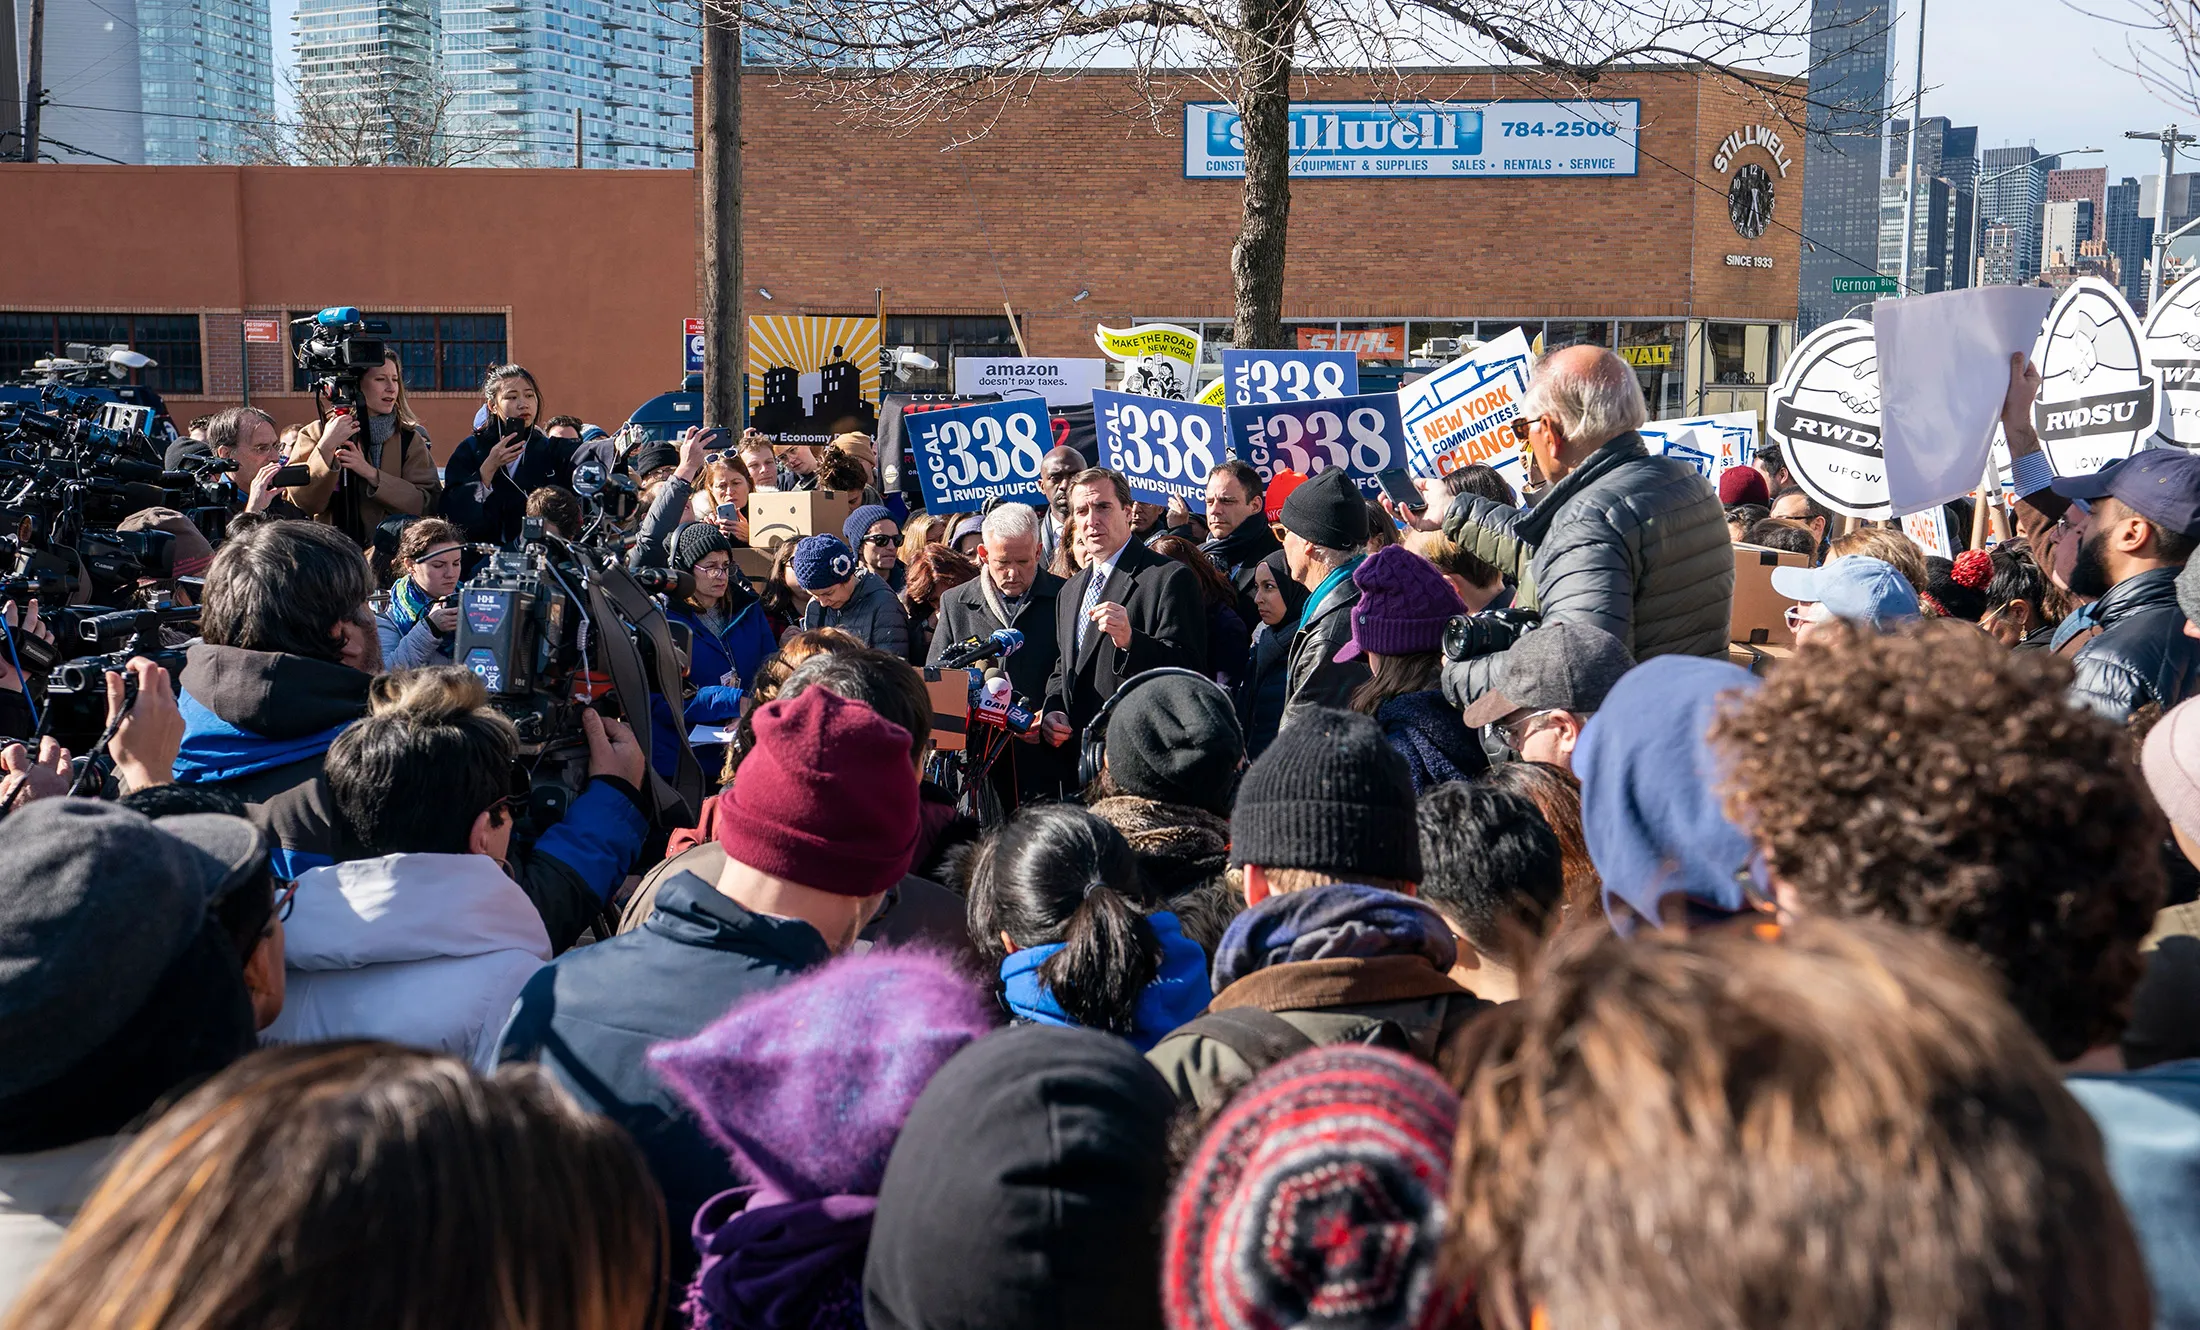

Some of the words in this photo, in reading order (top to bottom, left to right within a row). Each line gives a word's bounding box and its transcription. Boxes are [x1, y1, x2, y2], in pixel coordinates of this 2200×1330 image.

[1501, 121, 1616, 137] 784-2500
[1713, 124, 1792, 179] STILLWELL
[1295, 160, 1356, 171] EQUIPMENT
[1361, 160, 1370, 171] &
[1376, 160, 1428, 171] SUPPLIES
[1452, 159, 1486, 170] SALES
[1503, 159, 1552, 170] RENTALS
[1570, 158, 1616, 169] SERVICE
[1725, 254, 1751, 267] SINCE
[1753, 257, 1773, 268] 1933
[1835, 279, 1876, 291] Vernon
[1112, 338, 1140, 348] MAKE
[1140, 333, 1161, 345] THE
[1163, 334, 1194, 350] ROAD
[1147, 344, 1167, 352] NEW
[1170, 345, 1192, 359] YORK
[1308, 332, 1396, 352] STIHL
[1621, 346, 1672, 363] WALT
[985, 364, 1059, 376] amazon
[979, 377, 1015, 386] doesn't
[1018, 378, 1035, 386] pay
[1038, 378, 1068, 386] taxes.
[1234, 360, 1250, 406] CAL
[1251, 360, 1345, 405] 338
[1207, 387, 1224, 403] THE
[1423, 408, 1464, 442] NEW
[1463, 385, 1513, 421] YORK
[2045, 400, 2138, 431] RWDSU
[780, 433, 832, 444] Economy
[1432, 407, 1513, 454] COMMUNITIES
[1790, 416, 1884, 449] RWD
[939, 412, 1043, 486] 338
[1120, 404, 1216, 486] 338
[1247, 416, 1273, 484] OCAL
[1267, 407, 1391, 475] 338
[1436, 425, 1516, 477] CHANG
[922, 424, 953, 504] LOCAL
[1829, 463, 1882, 483] UFCW
[1128, 475, 1207, 500] RWDSU/UFC
[984, 700, 1007, 711] OAN
